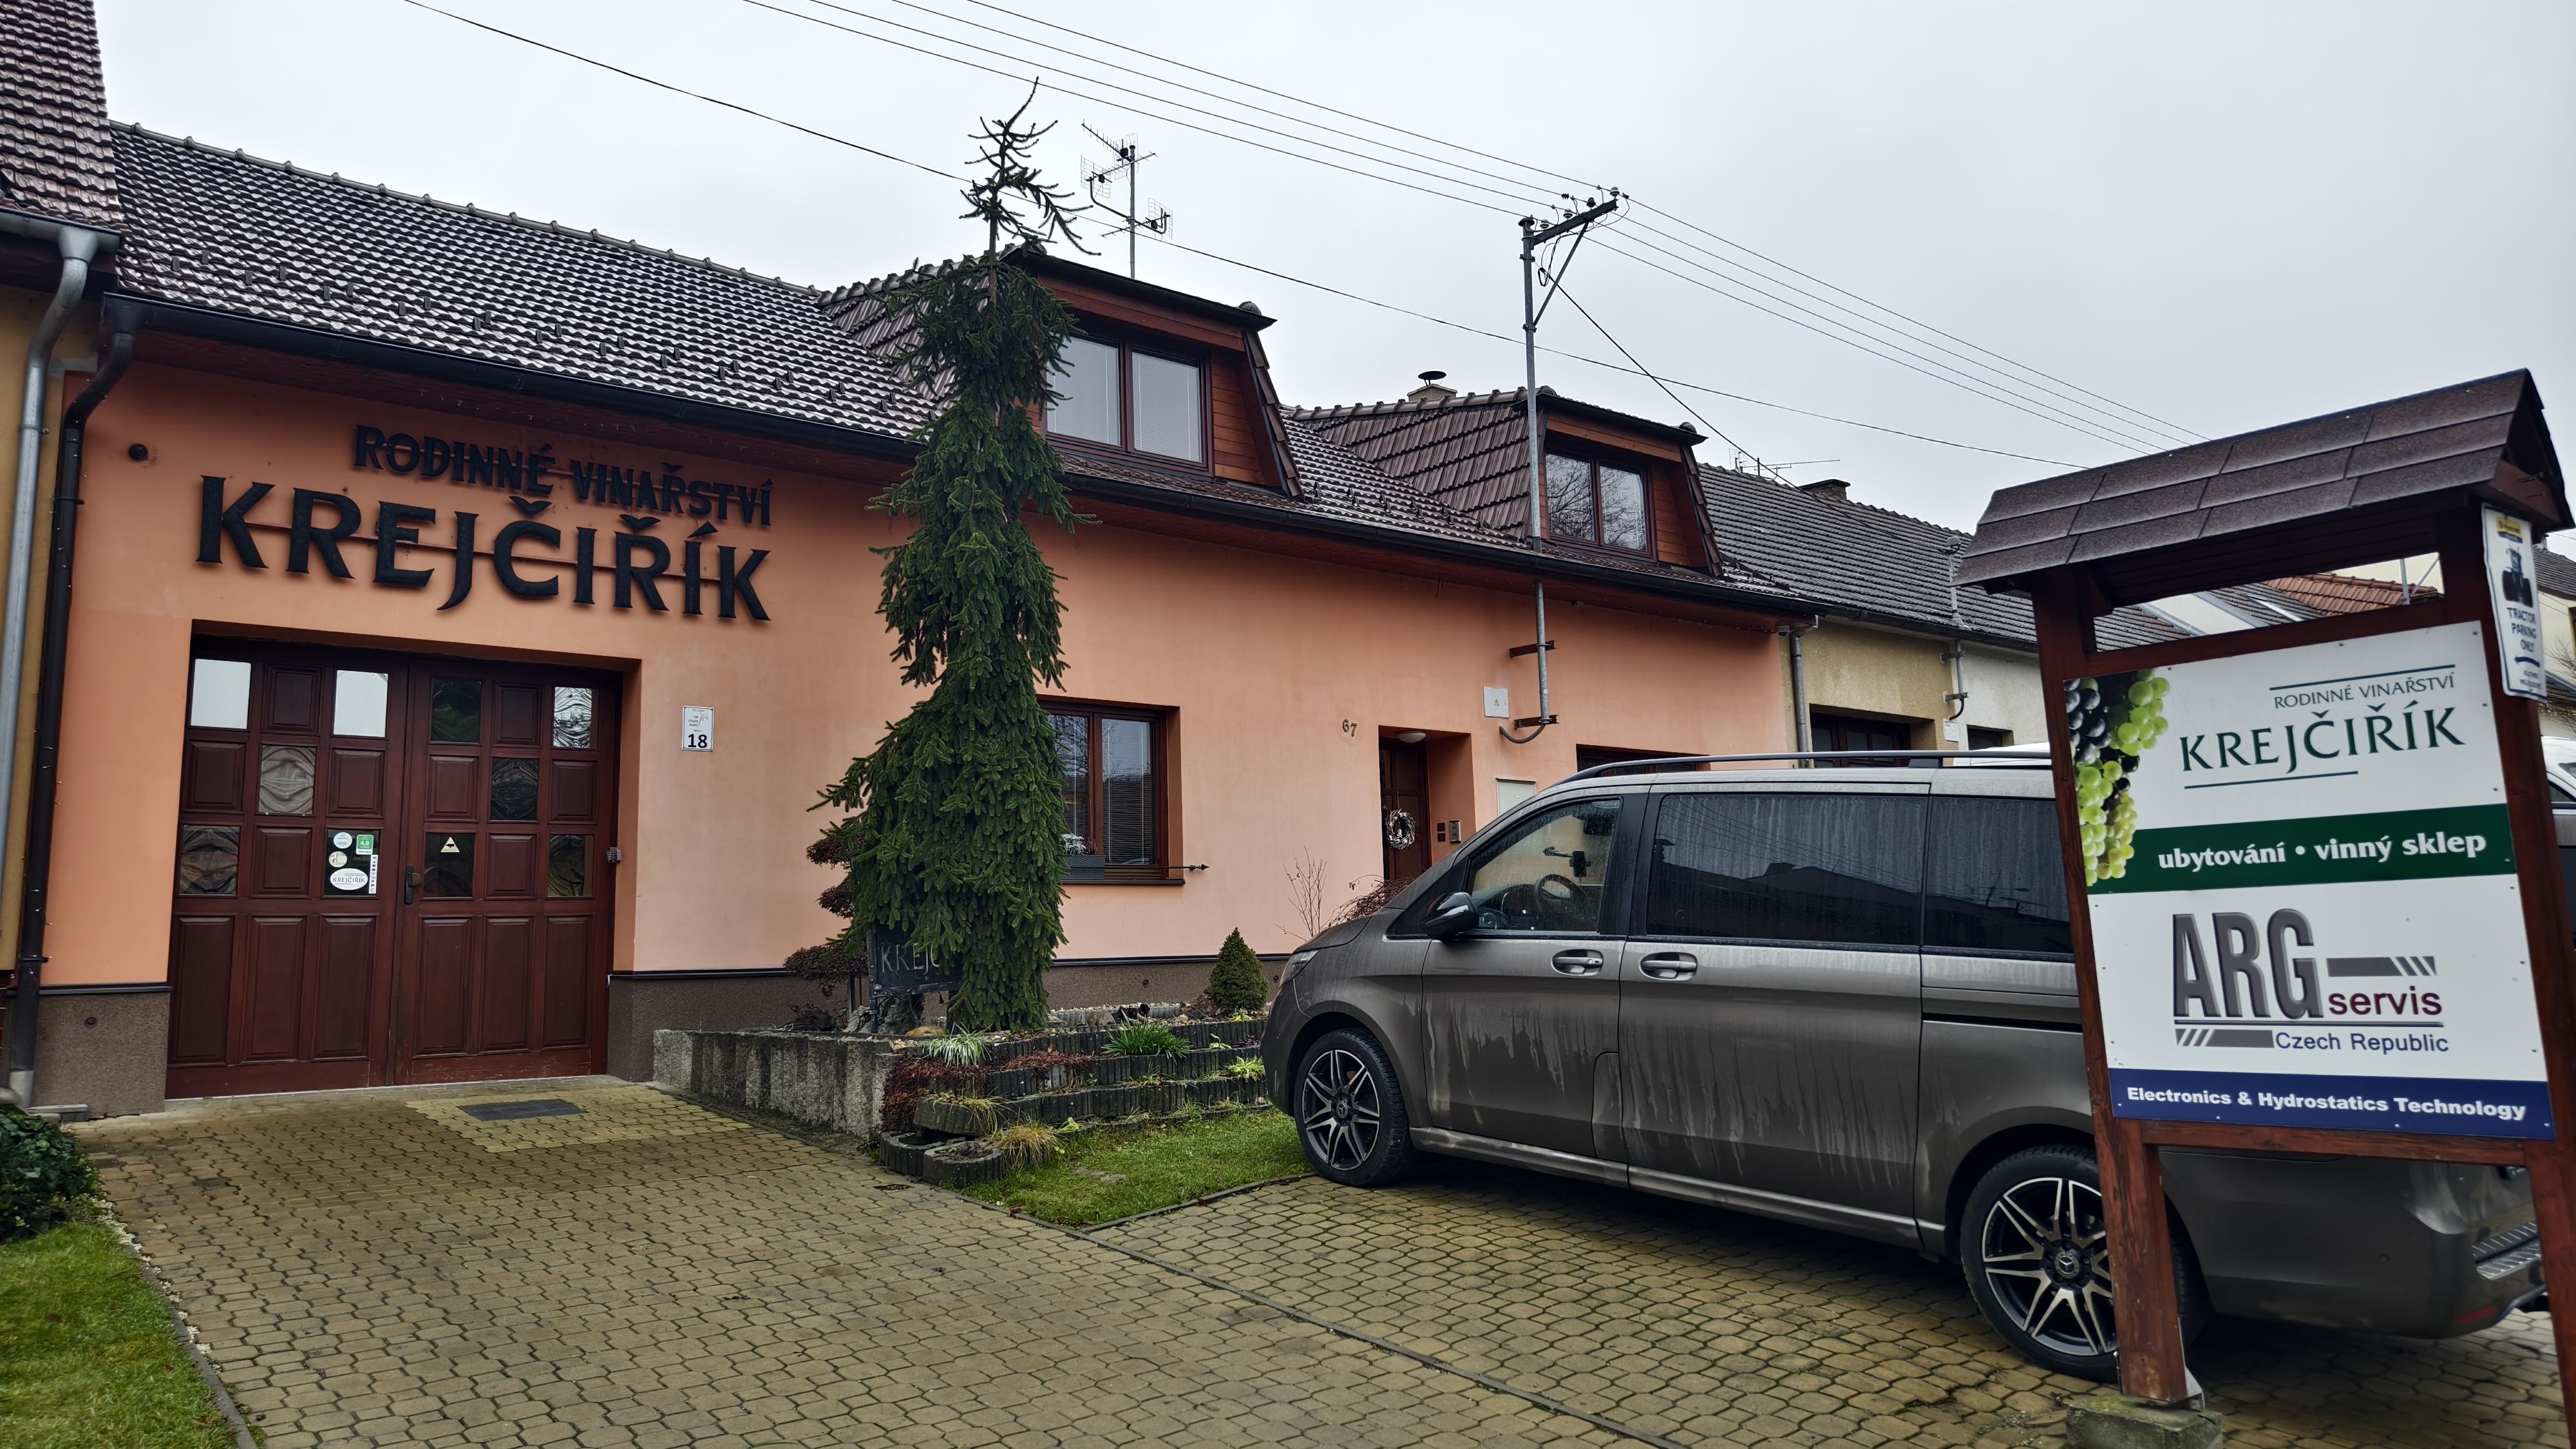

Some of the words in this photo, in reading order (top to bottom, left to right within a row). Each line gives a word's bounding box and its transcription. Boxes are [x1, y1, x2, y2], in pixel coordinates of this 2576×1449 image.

[353, 424, 556, 494] RODINNÉ
[570, 459, 772, 527] VINAŘSTVÍ
[195, 475, 772, 621] KREJČIŘÍK
[2511, 622, 2536, 639] PARKING
[2274, 685, 2354, 709] RODINNÉ
[2359, 672, 2456, 698] VINAŘSTVÍ
[687, 734, 708, 748] 18
[1342, 718, 1358, 737] 67
[2180, 700, 2466, 774] KREJČIŘÍK
[2158, 842, 2286, 872] ubytování
[2314, 835, 2392, 864] vinný
[2402, 831, 2487, 858] sklep
[2172, 907, 2324, 1019] ARG
[2327, 986, 2443, 1016] servis
[2275, 1032, 2341, 1050] Czech
[2351, 1032, 2449, 1055] Republic
[2127, 1086, 2231, 1106] Electronics
[2237, 1091, 2253, 1106] &
[2258, 1090, 2389, 1113] Hydrostatics
[2394, 1097, 2526, 1121] Technology
